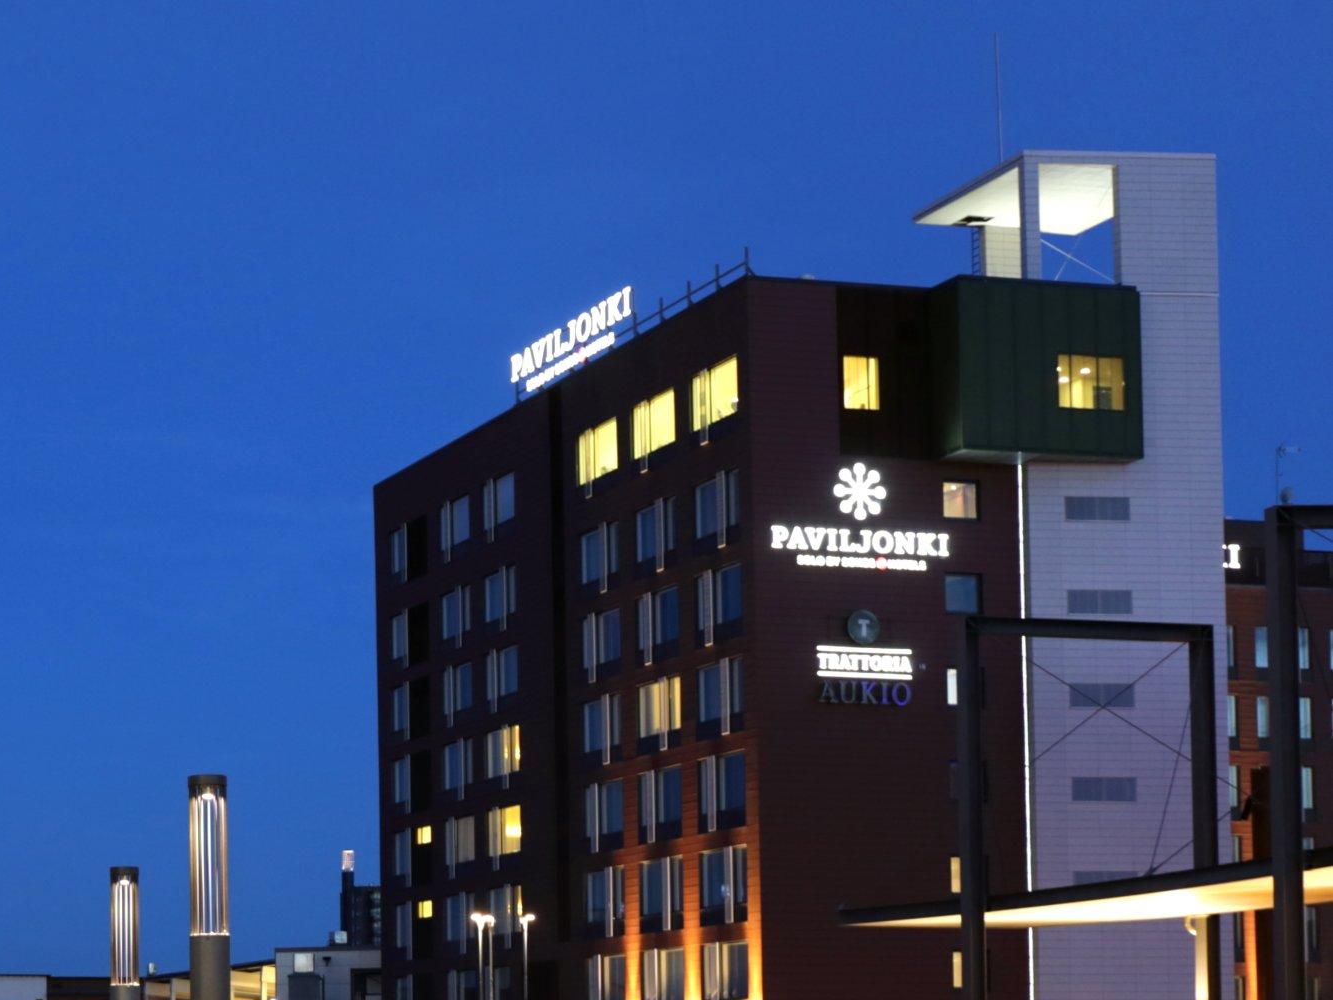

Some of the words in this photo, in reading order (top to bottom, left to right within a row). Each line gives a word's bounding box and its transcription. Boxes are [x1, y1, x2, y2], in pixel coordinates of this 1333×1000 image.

[510, 285, 632, 384] PAVILJONKI
[770, 524, 950, 557] PAVILJONKI
[857, 618, 870, 638] T
[816, 652, 913, 674] TRATTORIA
[818, 679, 913, 707] AUKIO
